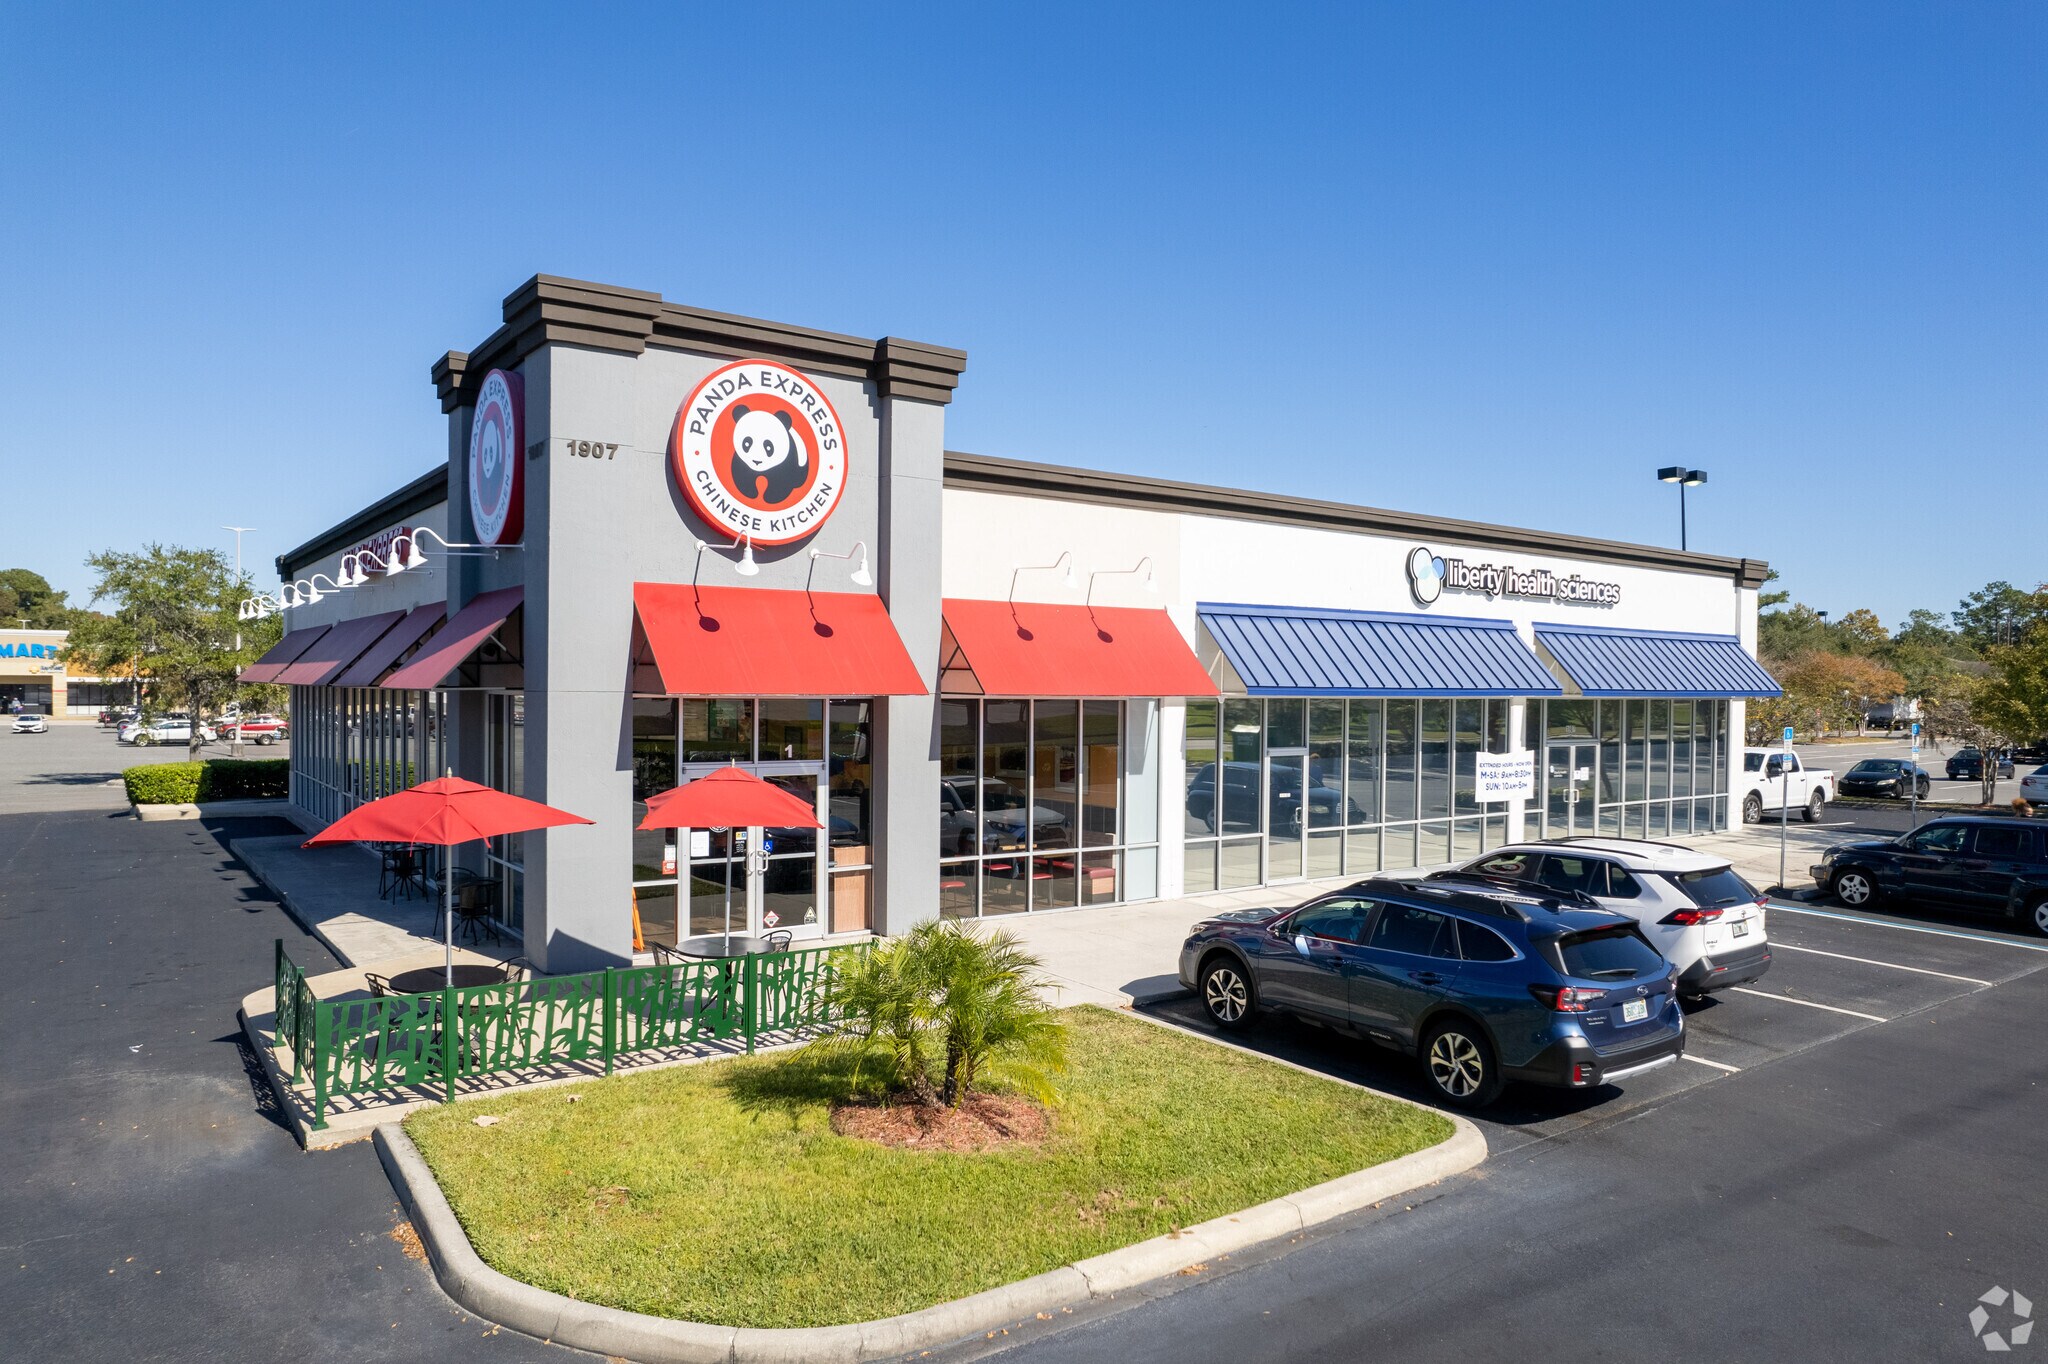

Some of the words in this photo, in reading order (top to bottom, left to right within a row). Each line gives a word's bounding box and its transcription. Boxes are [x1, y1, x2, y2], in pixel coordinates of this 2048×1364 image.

[472, 389, 488, 458] PANDA
[489, 381, 511, 439] EXPRESS
[690, 372, 752, 435] PANDA
[761, 371, 837, 451] EXPRESS
[567, 440, 619, 460] 1907
[697, 470, 762, 531] CHINESE
[770, 482, 832, 532] KITCHEN
[1448, 560, 1506, 596] liberty
[1507, 566, 1557, 598] health
[1558, 575, 1621, 605] sciences
[785, 745, 793, 758] 1
